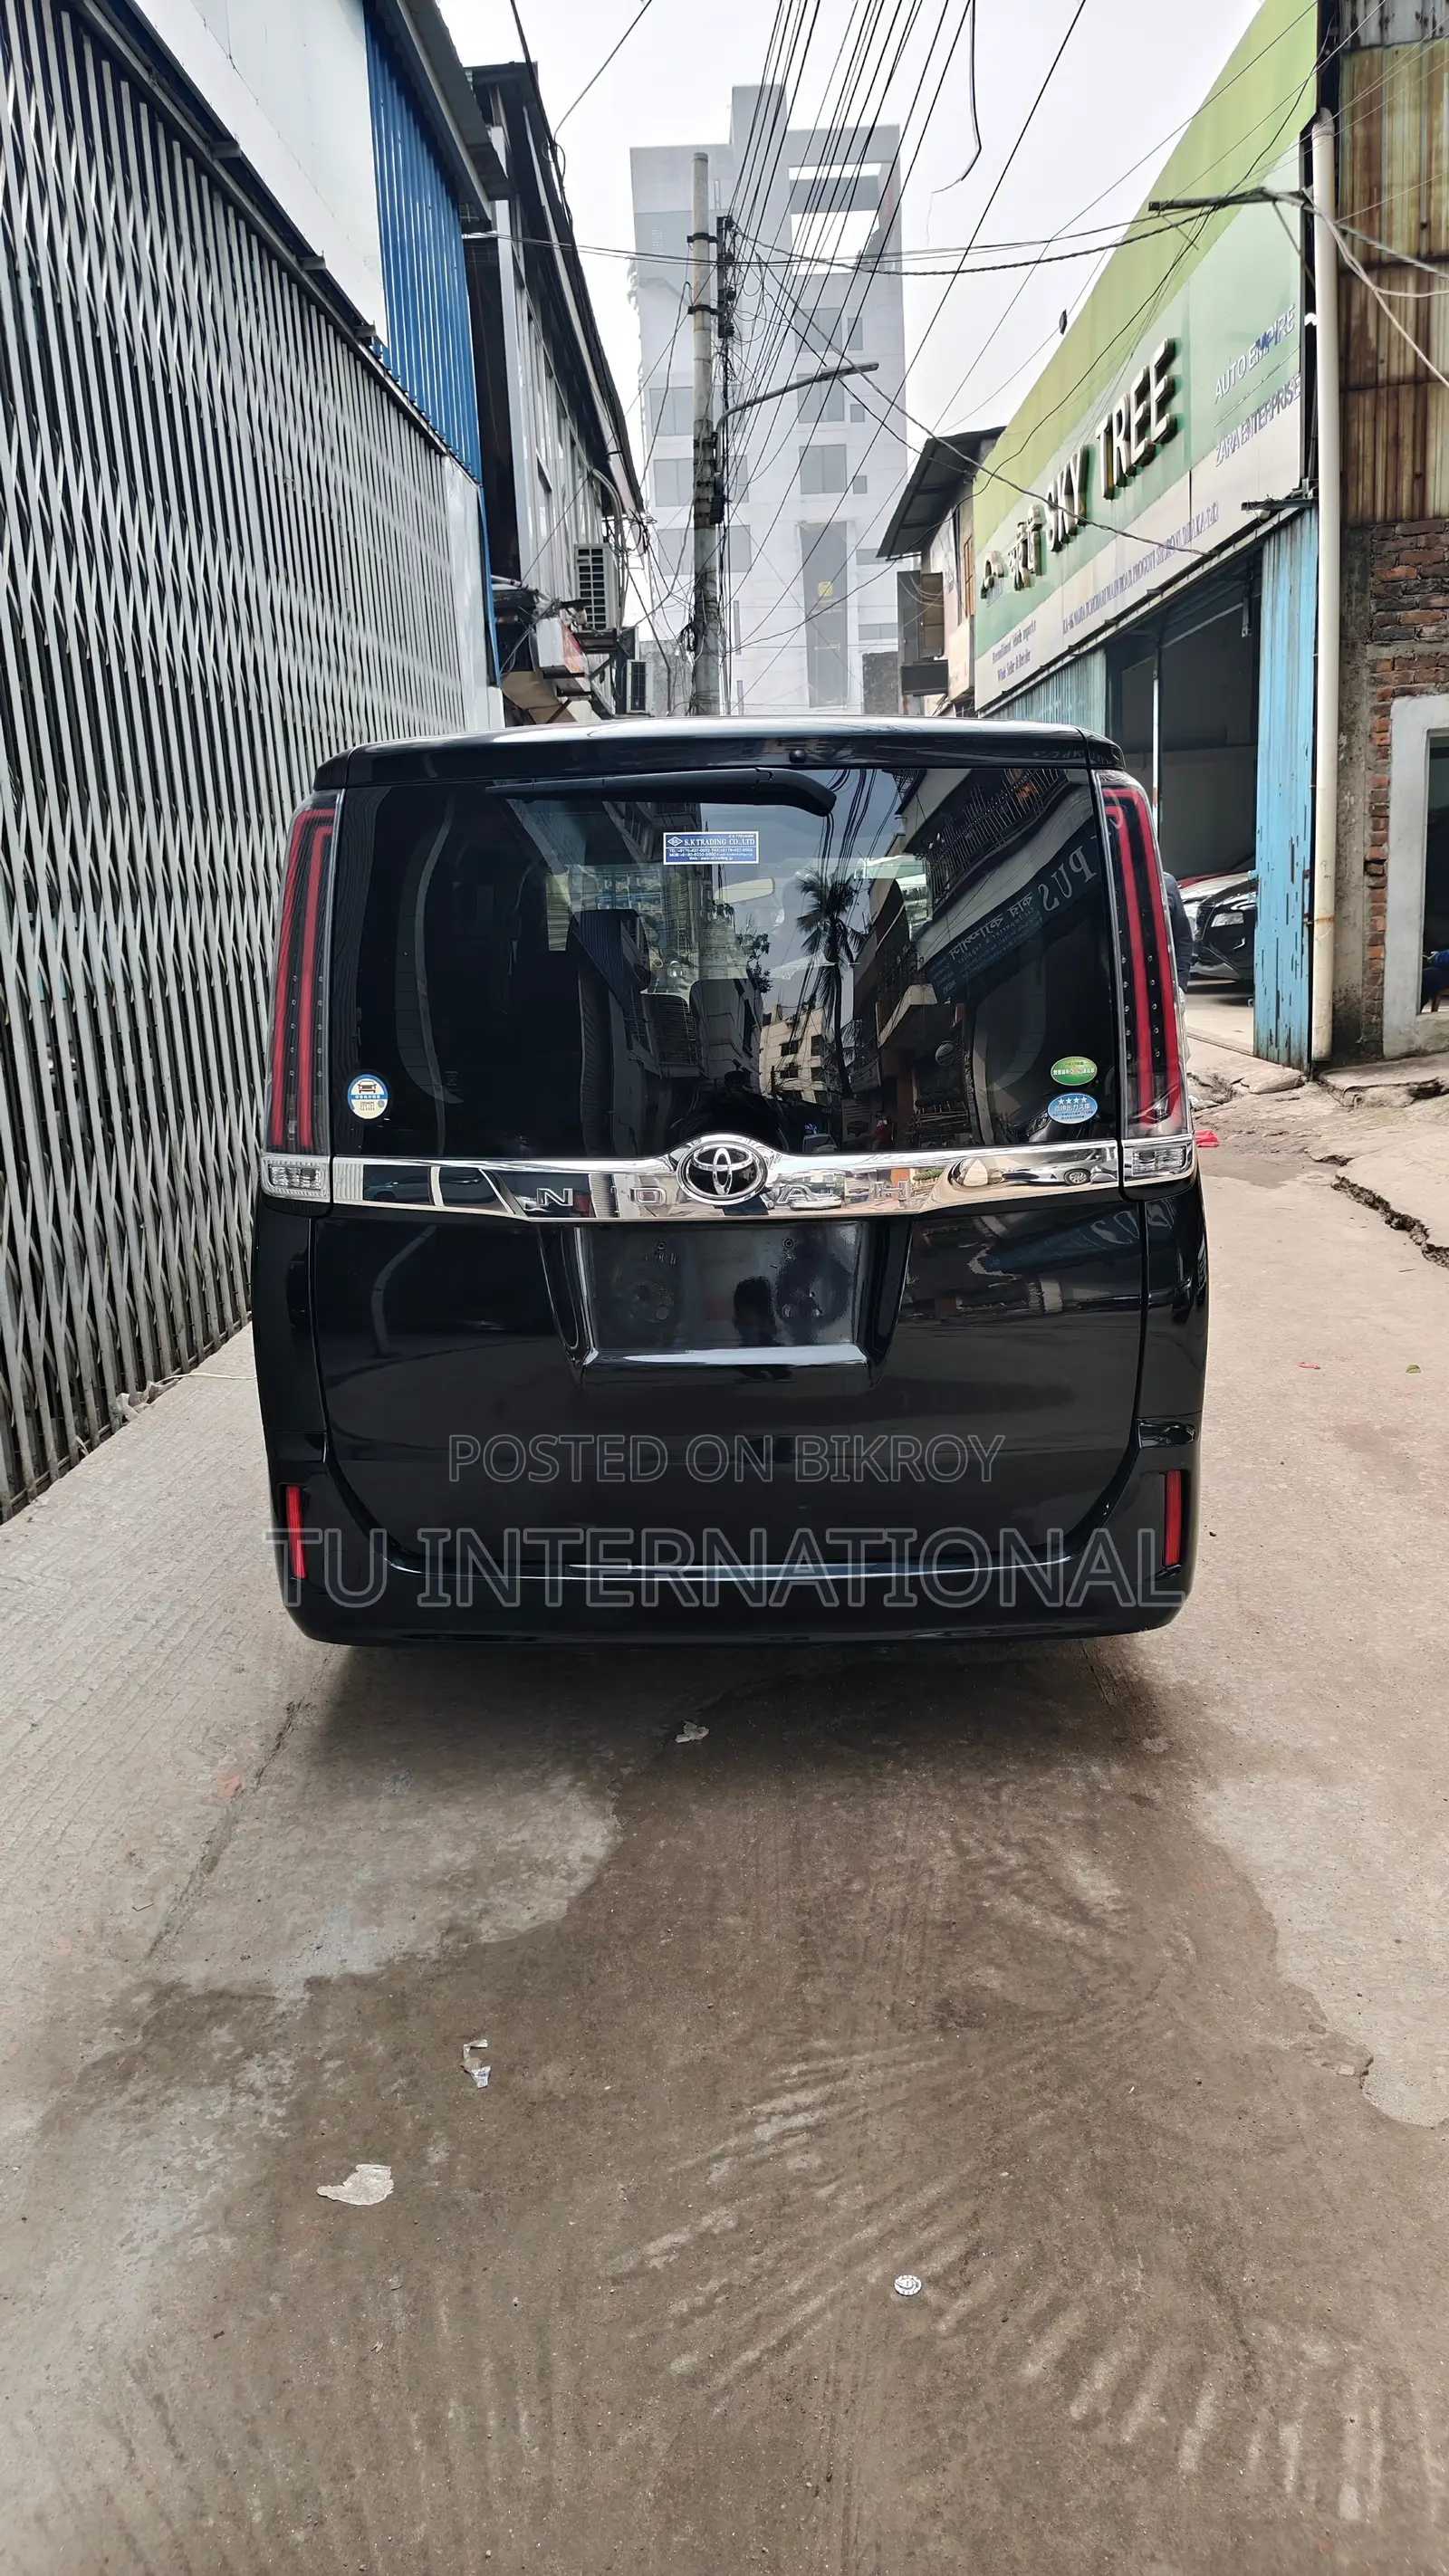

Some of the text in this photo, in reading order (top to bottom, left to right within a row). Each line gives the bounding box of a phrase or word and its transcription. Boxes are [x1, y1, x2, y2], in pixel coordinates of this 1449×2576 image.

[1214, 303, 1295, 405] AUTO EMPIRE
[1046, 445, 1089, 551] SKY
[1095, 338, 1177, 501] TREE
[1215, 429, 1241, 467] ZARA
[696, 838, 726, 846] TRADING
